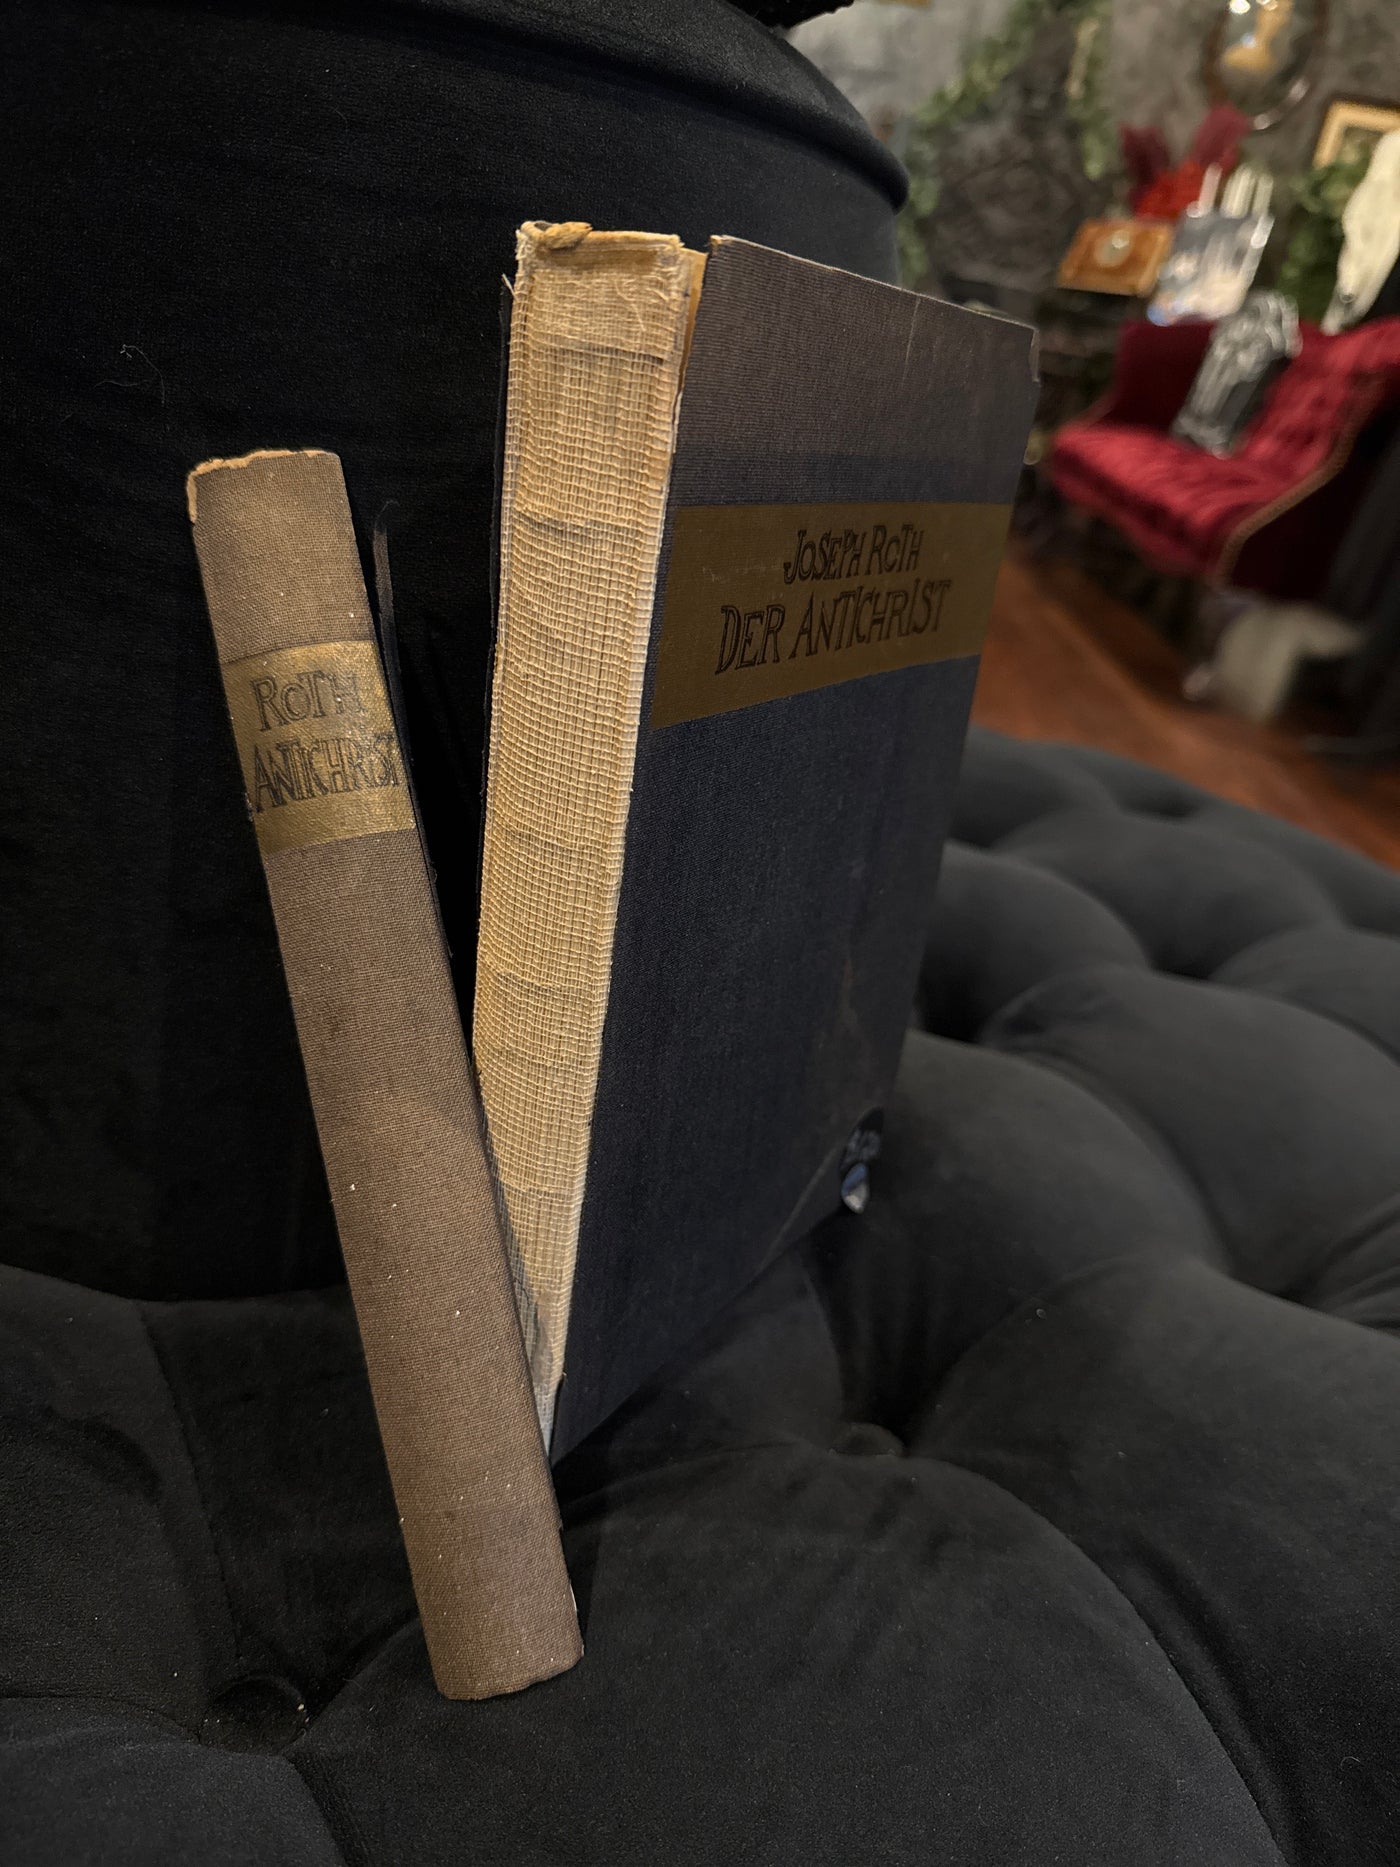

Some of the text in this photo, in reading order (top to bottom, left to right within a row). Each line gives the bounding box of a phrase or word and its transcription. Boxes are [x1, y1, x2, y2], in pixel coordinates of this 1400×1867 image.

[783, 524, 924, 584] JOSEPH ROTH
[714, 578, 952, 676] DER ANTICHRIST
[252, 669, 367, 732] ROTH
